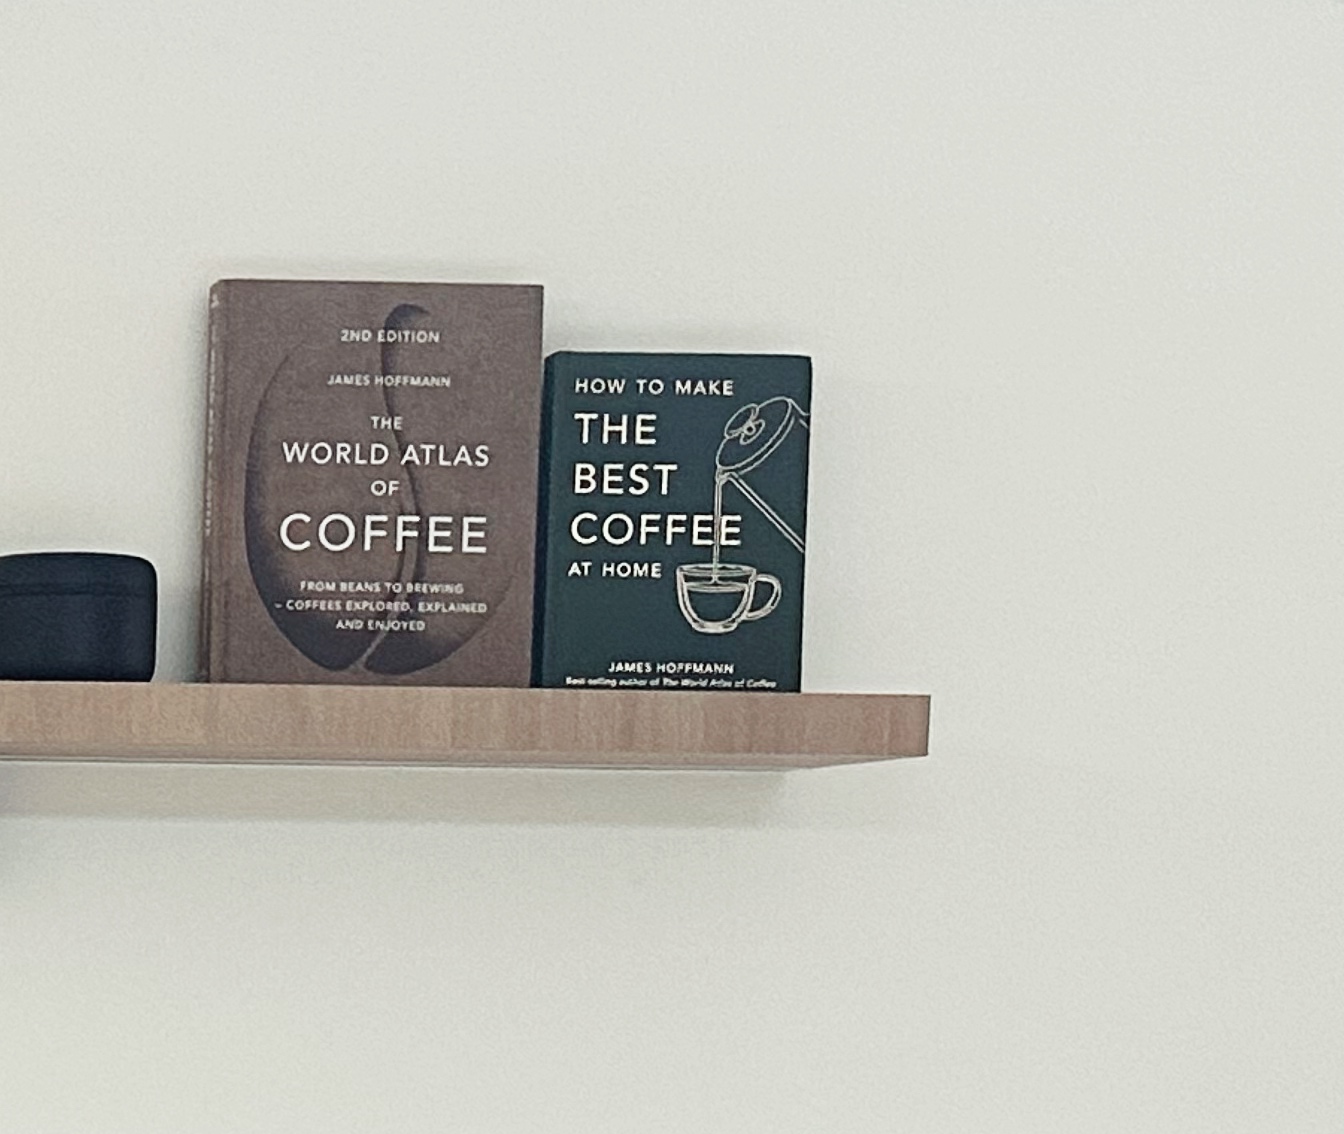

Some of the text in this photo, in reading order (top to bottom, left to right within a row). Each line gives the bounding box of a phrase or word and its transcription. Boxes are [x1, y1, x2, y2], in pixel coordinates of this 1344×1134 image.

[340, 329, 440, 344] 2ND EDITION
[327, 374, 451, 388] JAMES HOFFMANN
[574, 378, 735, 396] HOW TO MAKE
[370, 416, 403, 431] THE
[574, 412, 657, 445] THE
[282, 442, 490, 467] WORLD ATLAS
[573, 463, 678, 496] BEST
[370, 481, 400, 497] OF
[279, 513, 488, 554] COFFEE
[570, 512, 743, 547] COFFEE
[567, 562, 662, 579] AT HOME
[300, 581, 336, 592] FROM
[340, 582, 381, 593] BEANS
[384, 582, 403, 593] TO
[285, 600, 342, 611] COFFEES
[417, 602, 488, 613] EXPLAINED
[335, 619, 426, 631] AND ENJOYED
[608, 661, 735, 674] JAMES HOFFMANN
